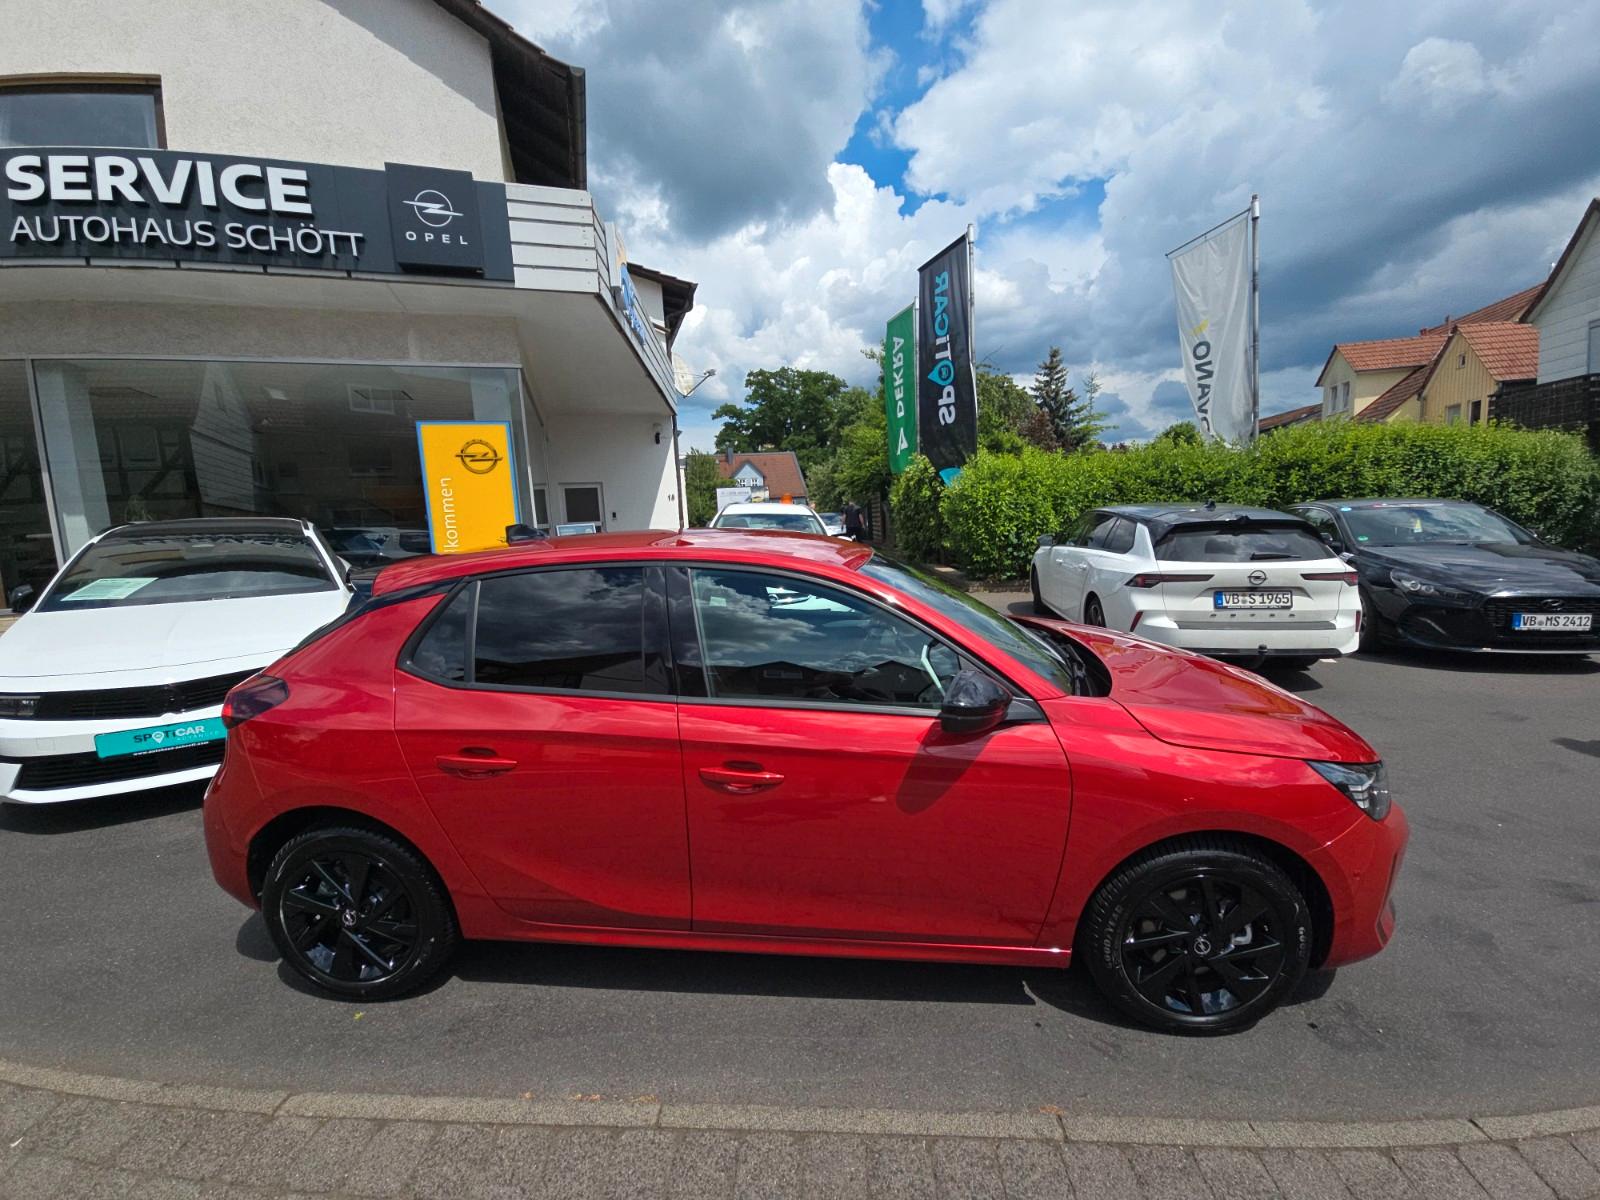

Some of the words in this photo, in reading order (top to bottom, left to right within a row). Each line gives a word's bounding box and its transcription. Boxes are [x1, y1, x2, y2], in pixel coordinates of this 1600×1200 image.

[5, 154, 313, 215] SERVICE
[9, 215, 216, 247] AUTOHAUS
[224, 221, 364, 258] SCHÖTT
[405, 230, 470, 246] OPEL
[1223, 592, 1240, 605] VB
[1248, 592, 1257, 605] S
[1259, 592, 1290, 605] 1965
[1522, 615, 1537, 626] VB
[1545, 616, 1561, 627] MS
[1562, 616, 1590, 627] 2412
